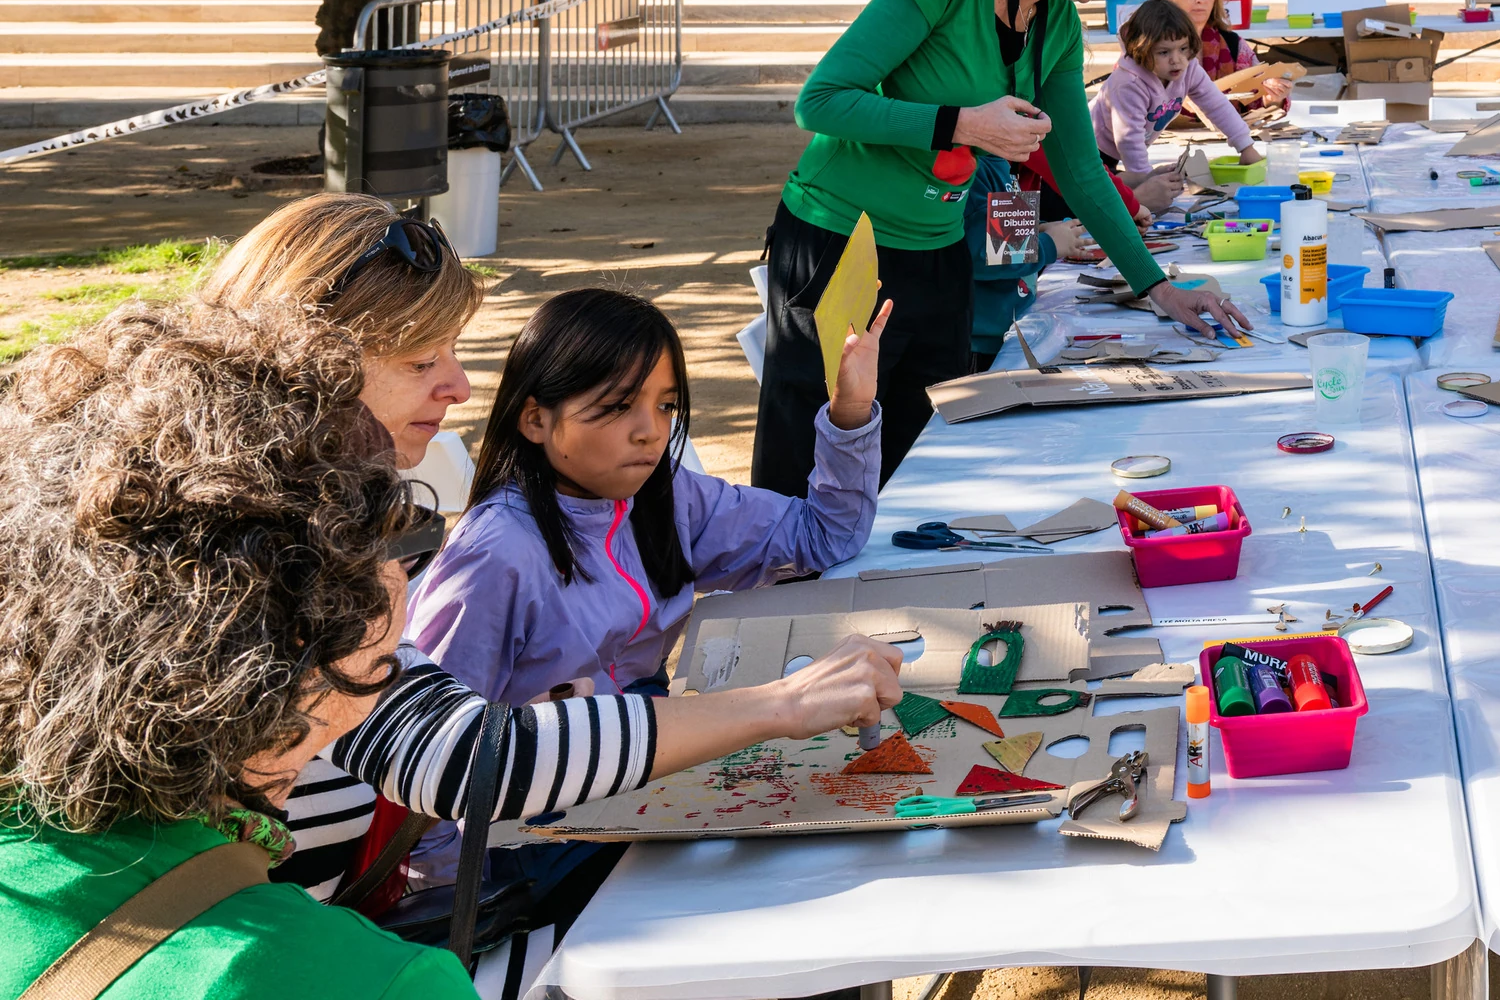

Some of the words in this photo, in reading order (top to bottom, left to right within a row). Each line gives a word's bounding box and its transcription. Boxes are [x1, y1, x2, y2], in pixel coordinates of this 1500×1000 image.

[993, 210, 1036, 218] Barcelona
[1004, 218, 1036, 227] Dibuixa
[1003, 248, 1034, 256] Organització
